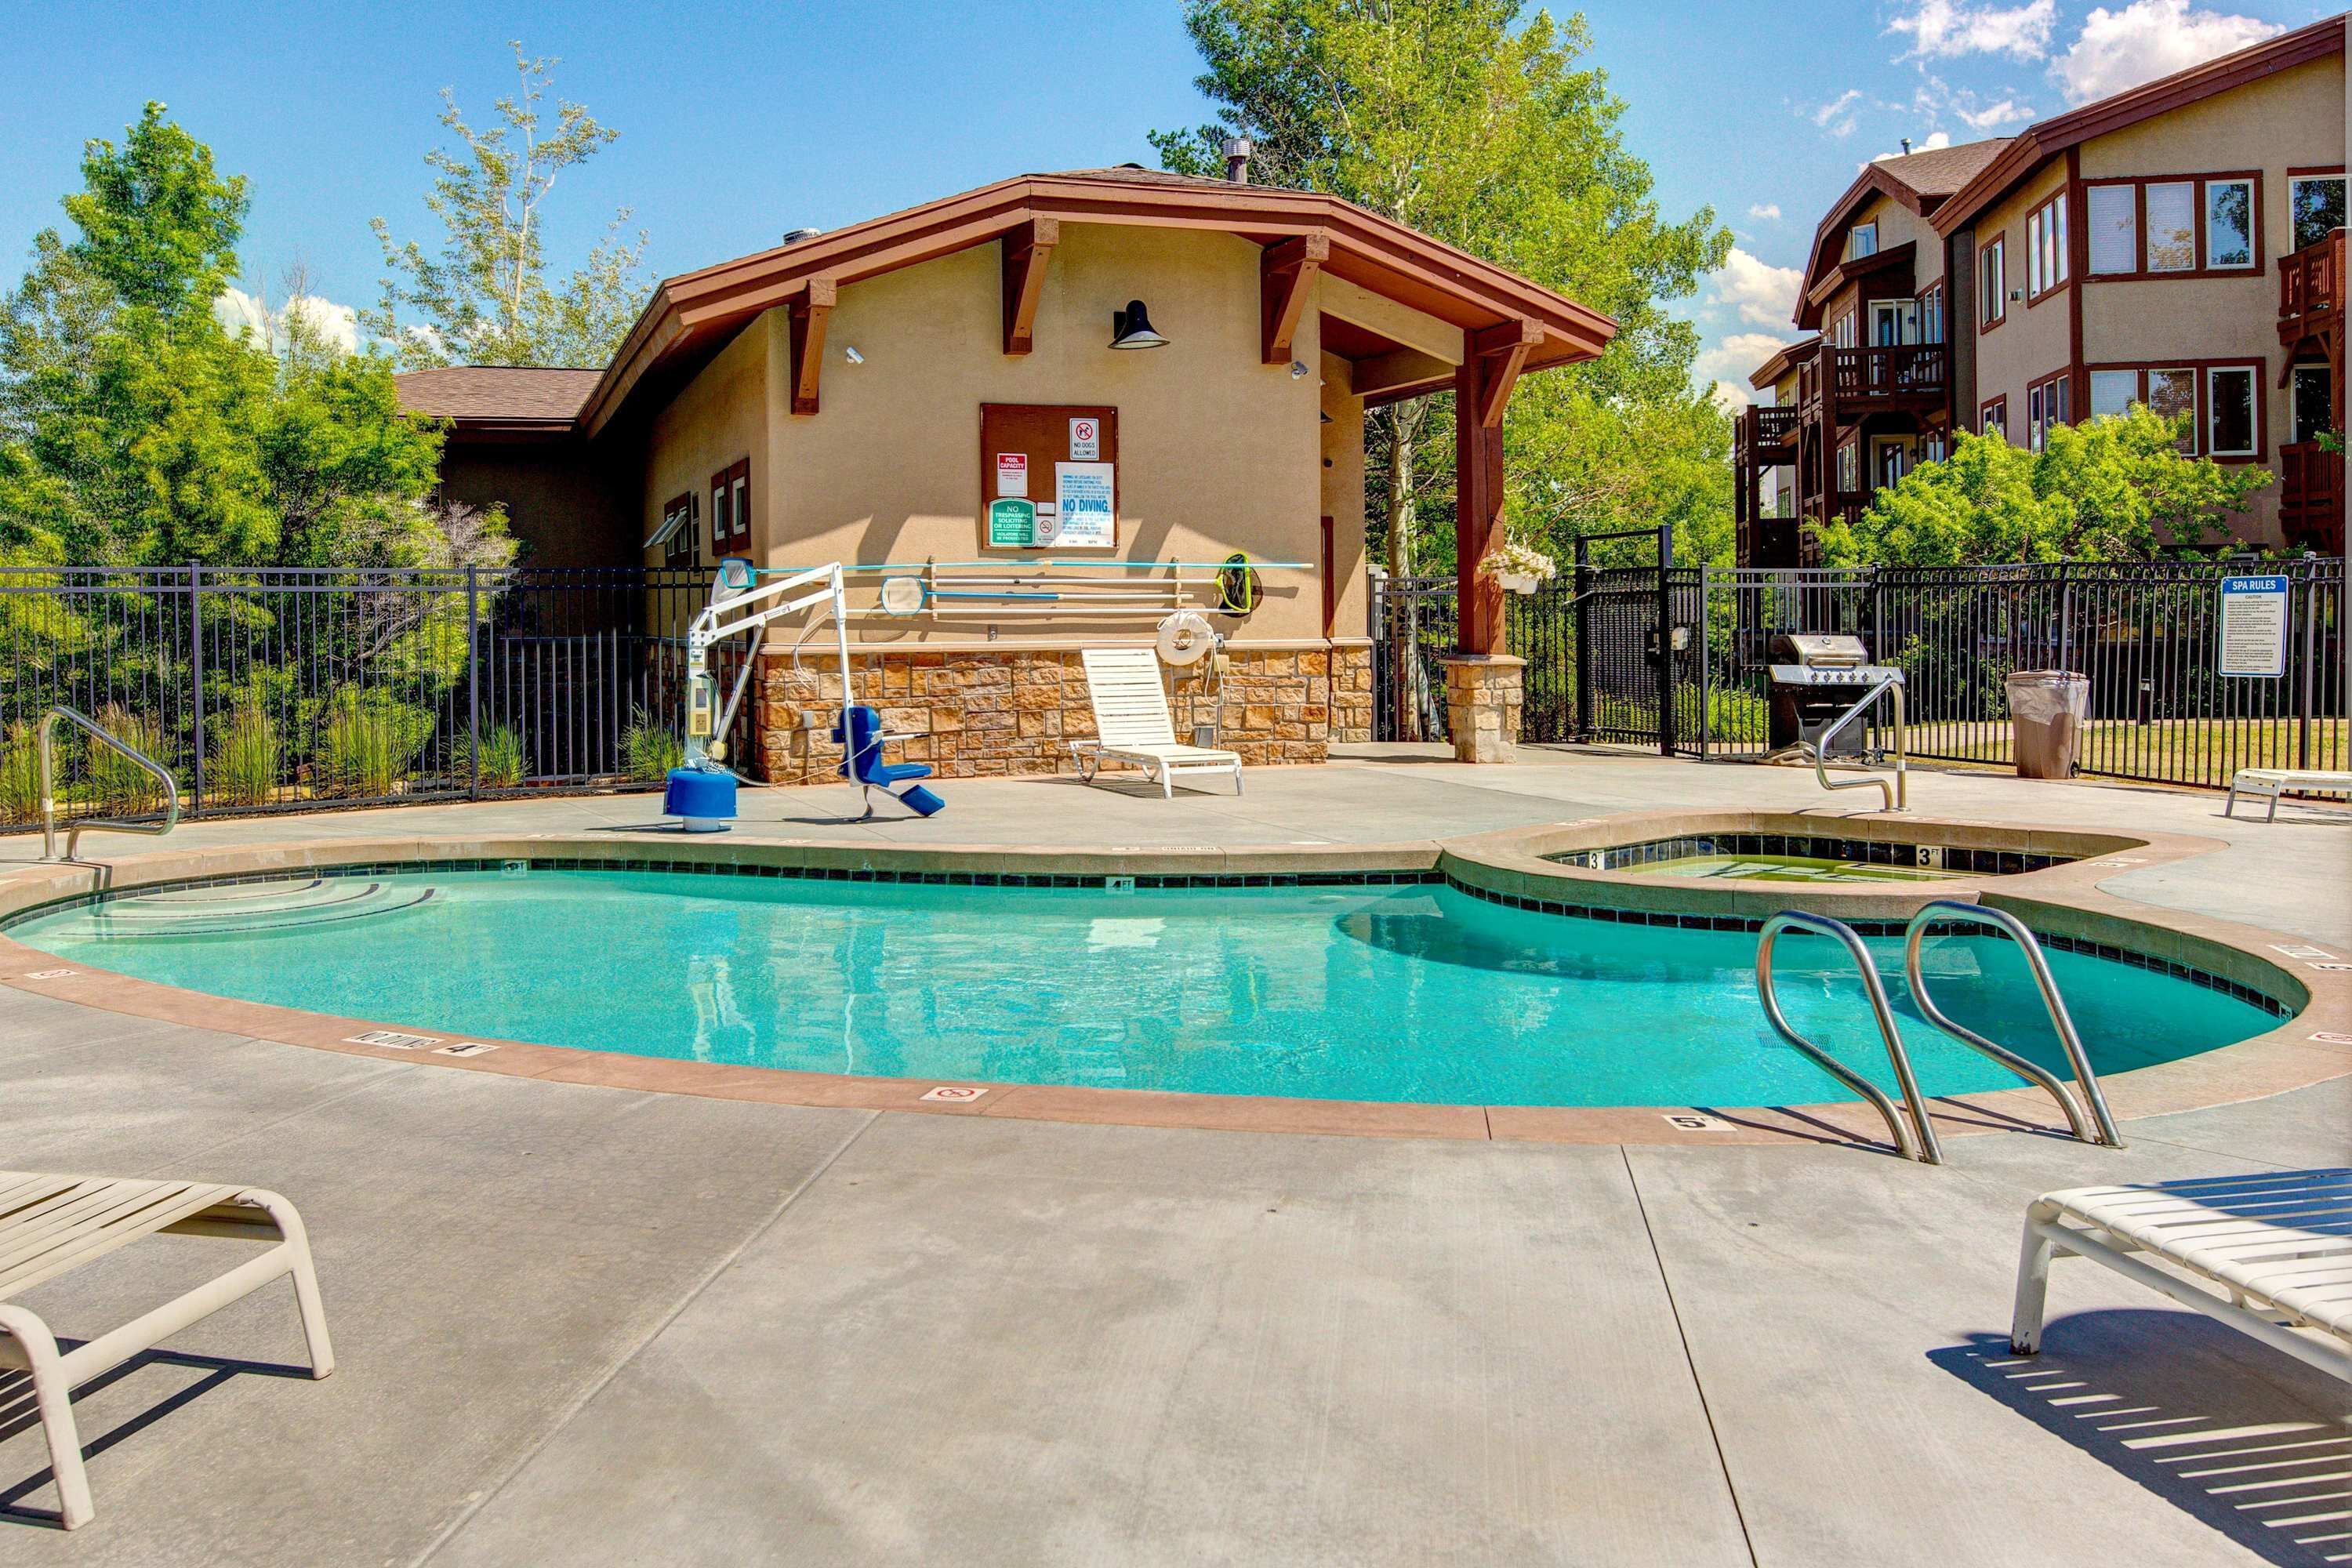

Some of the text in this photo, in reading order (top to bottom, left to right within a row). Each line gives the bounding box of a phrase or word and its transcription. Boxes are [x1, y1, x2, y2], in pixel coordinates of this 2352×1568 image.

[1062, 499, 1076, 512] NO
[1079, 499, 1110, 513] DIVING.
[2232, 580, 2277, 590] SPA RULES
[1591, 853, 1598, 869] 3
[1918, 848, 1931, 866] 3
[445, 1044, 479, 1053] 4
[1670, 1117, 1707, 1128] 5
